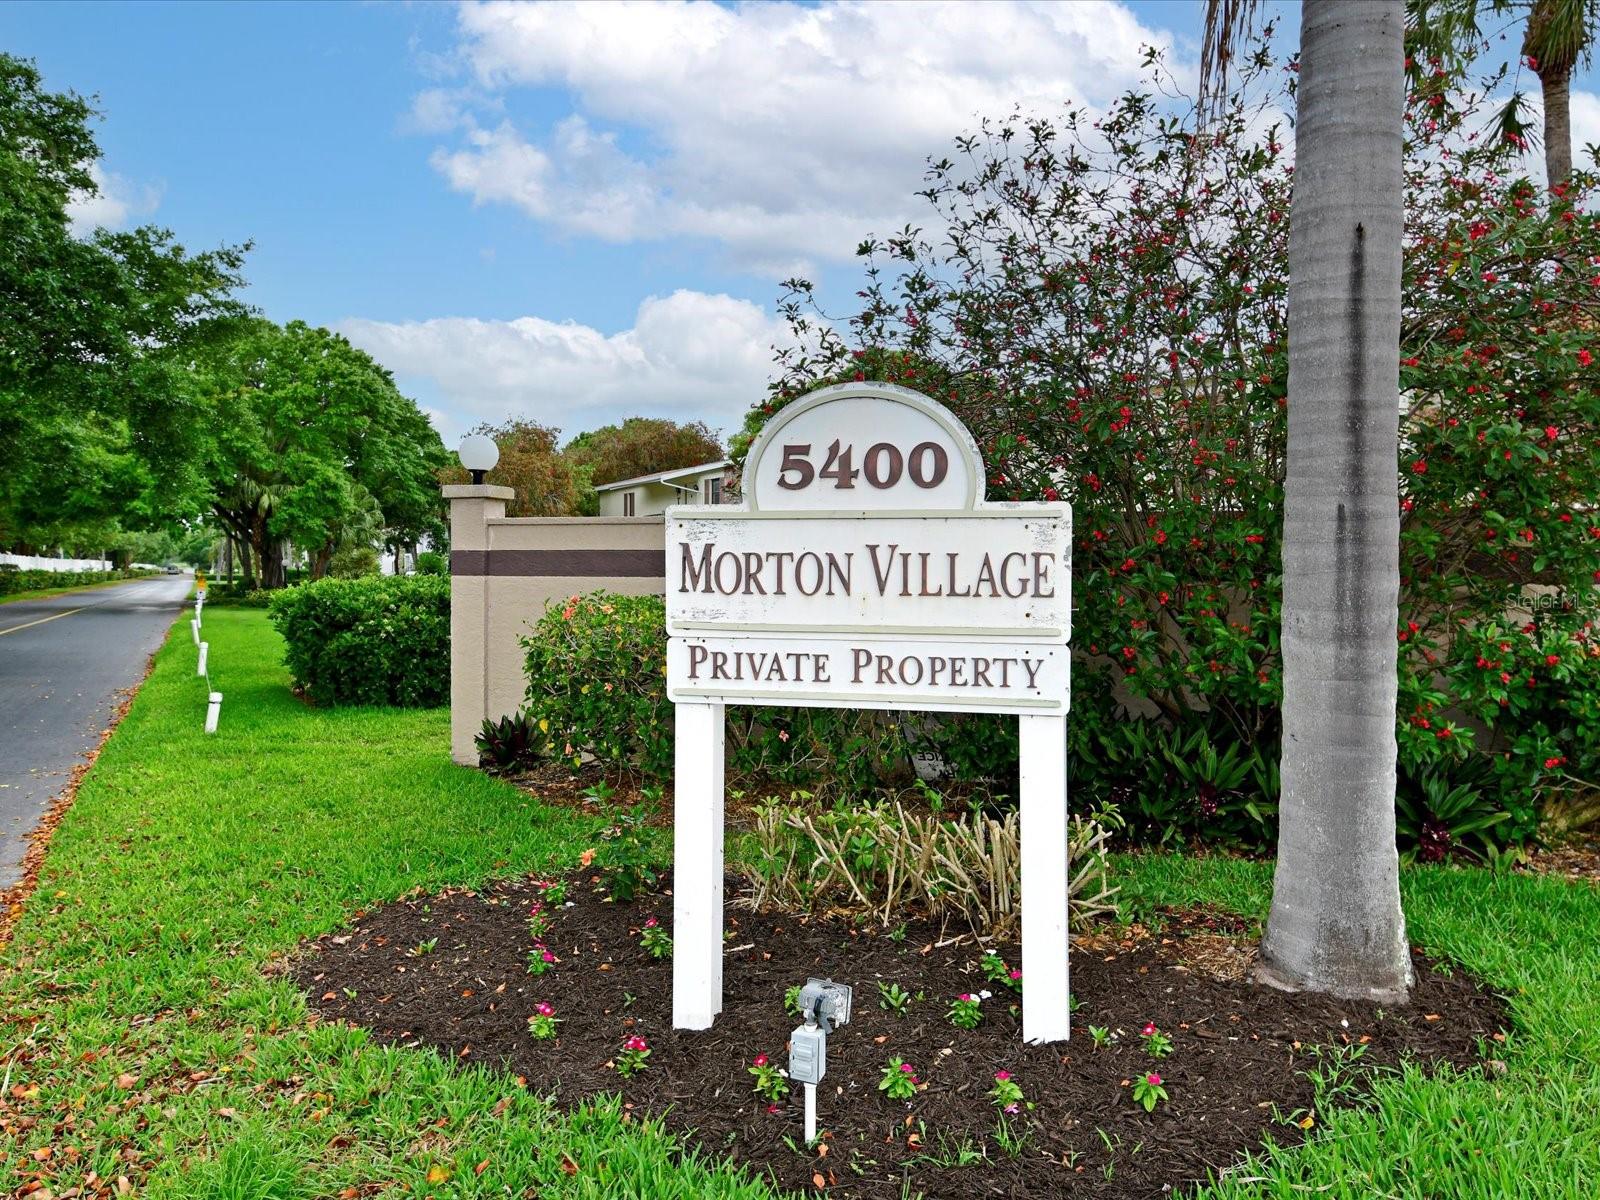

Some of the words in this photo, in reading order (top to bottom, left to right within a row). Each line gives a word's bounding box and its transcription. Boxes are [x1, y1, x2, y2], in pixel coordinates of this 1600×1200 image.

[777, 438, 948, 489] 5400
[678, 542, 854, 596] MORTON
[865, 544, 1055, 598] VILLAGE
[687, 645, 831, 682] PRIVATE
[850, 648, 1044, 689] PROPERTY
